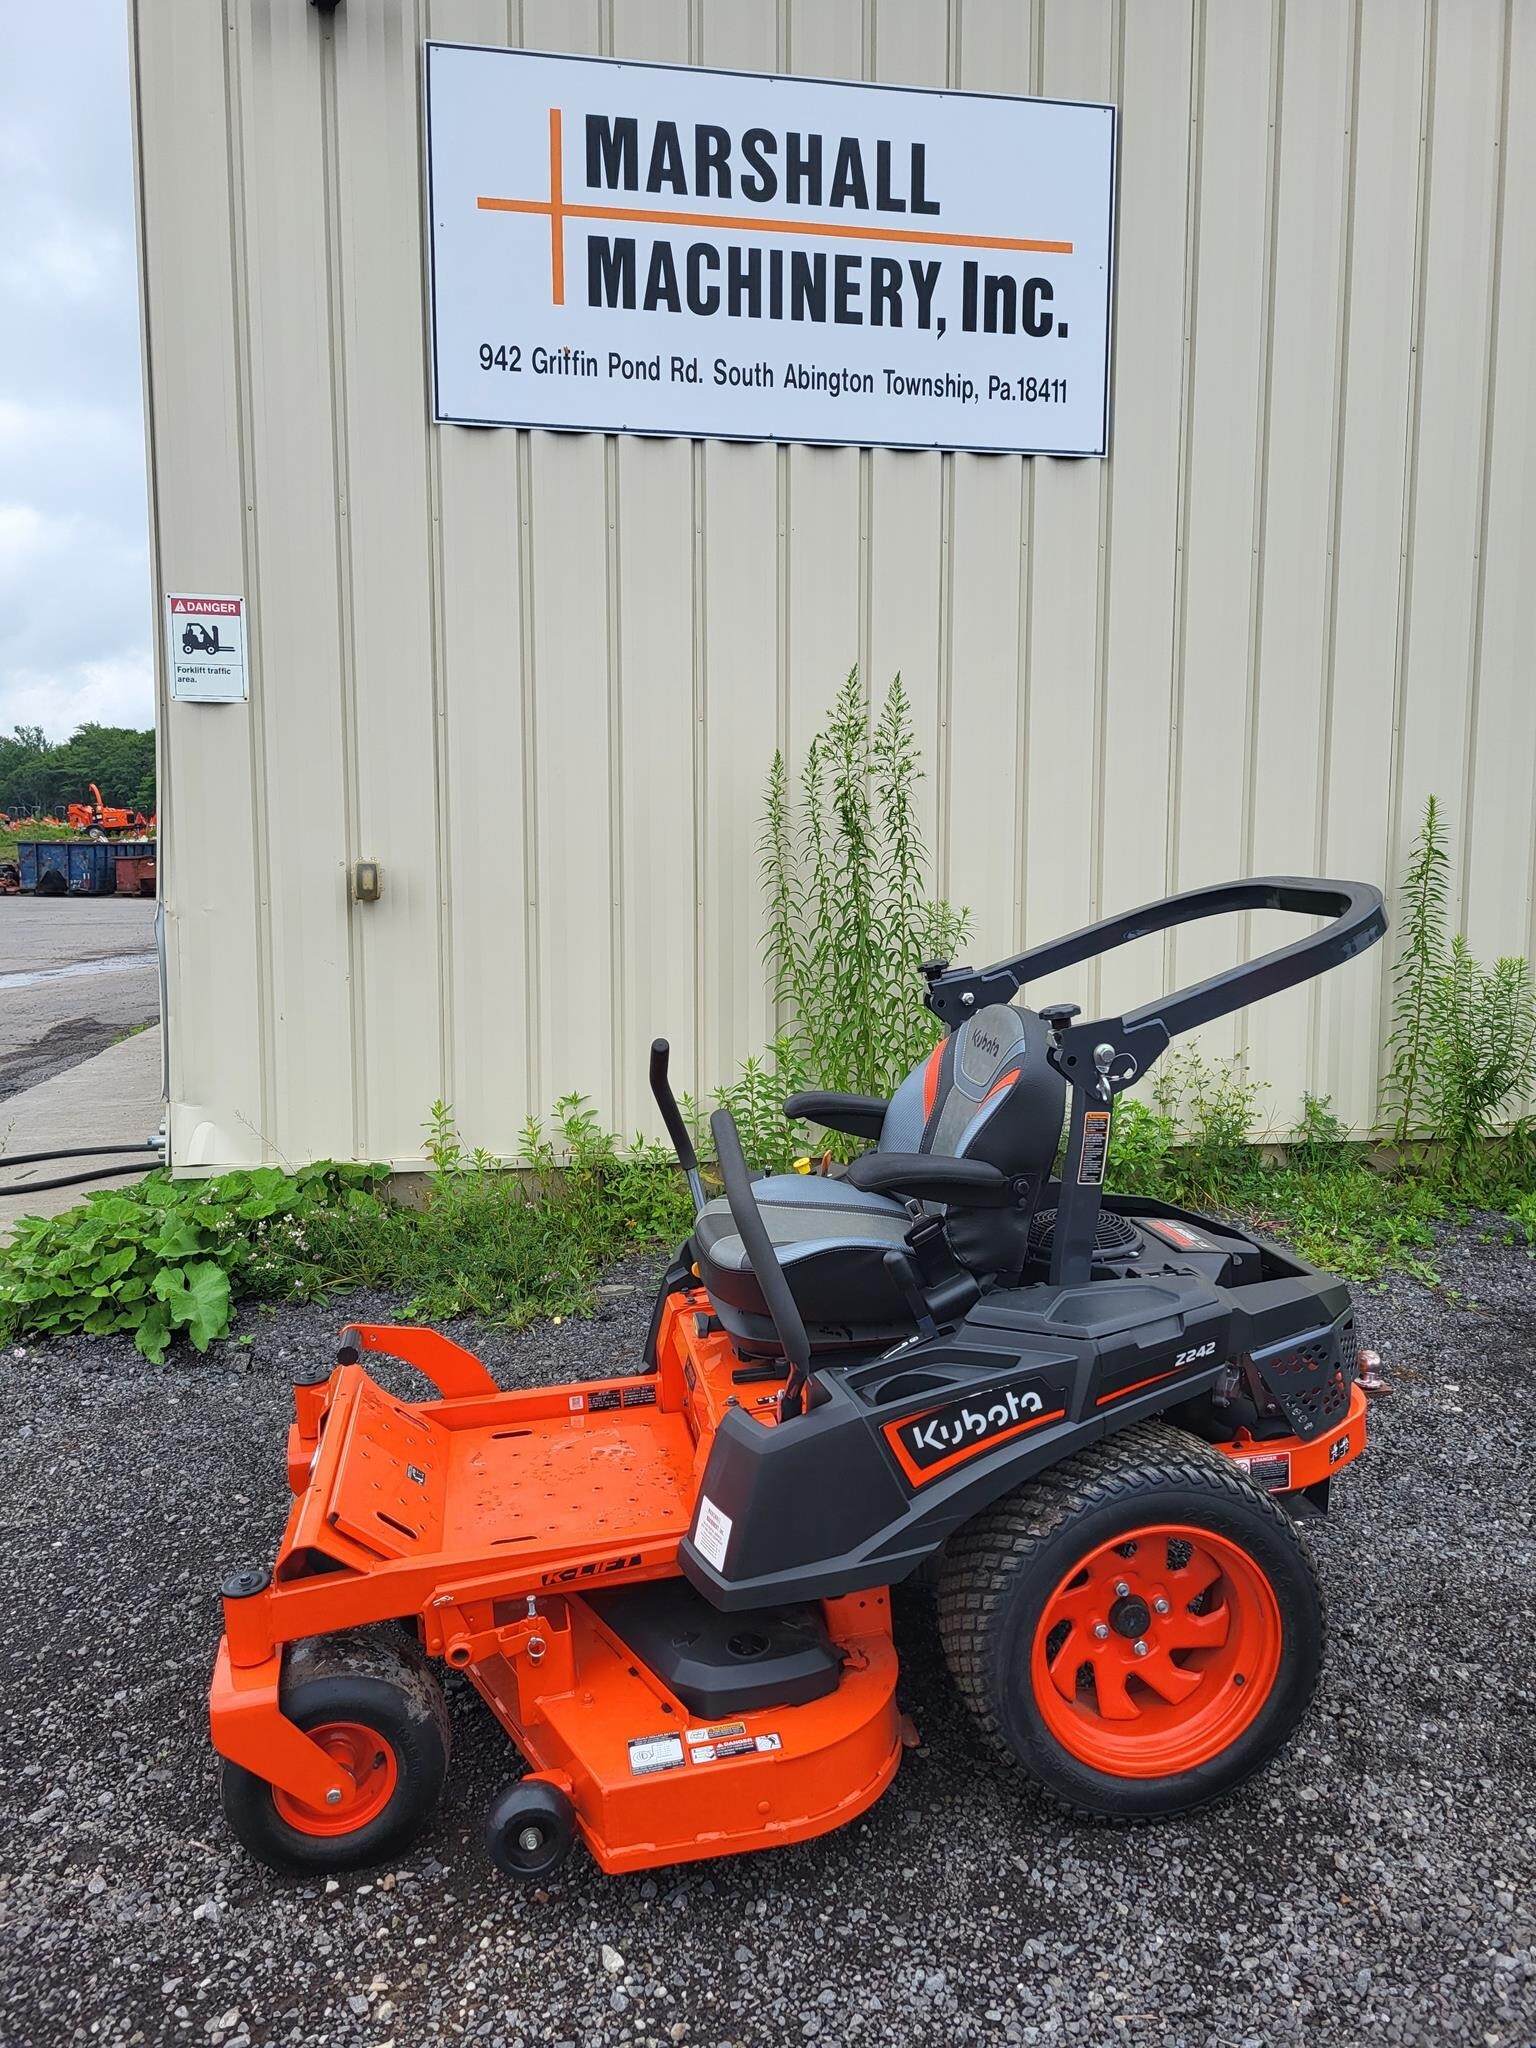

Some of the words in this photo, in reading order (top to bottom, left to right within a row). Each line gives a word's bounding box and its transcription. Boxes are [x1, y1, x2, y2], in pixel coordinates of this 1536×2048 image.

[586, 114, 940, 215] MARSHALL
[588, 236, 946, 340] MACHINERY,
[963, 261, 1068, 338] Inc.
[480, 343, 522, 373] 942
[532, 347, 597, 377] Griffin
[609, 353, 660, 381] Pond
[671, 357, 703, 384] Rd.
[713, 359, 773, 388] South
[784, 364, 873, 398] Abington
[882, 369, 979, 405] Township,
[989, 375, 1067, 404] Pa.18411
[187, 602, 236, 614] DANGER
[177, 665, 206, 674] Forklift
[972, 1028, 999, 1057] Kubota
[1175, 1342, 1215, 1366] Z242
[913, 1392, 1042, 1449] Kubota
[545, 1556, 640, 1584] K-LIFT
